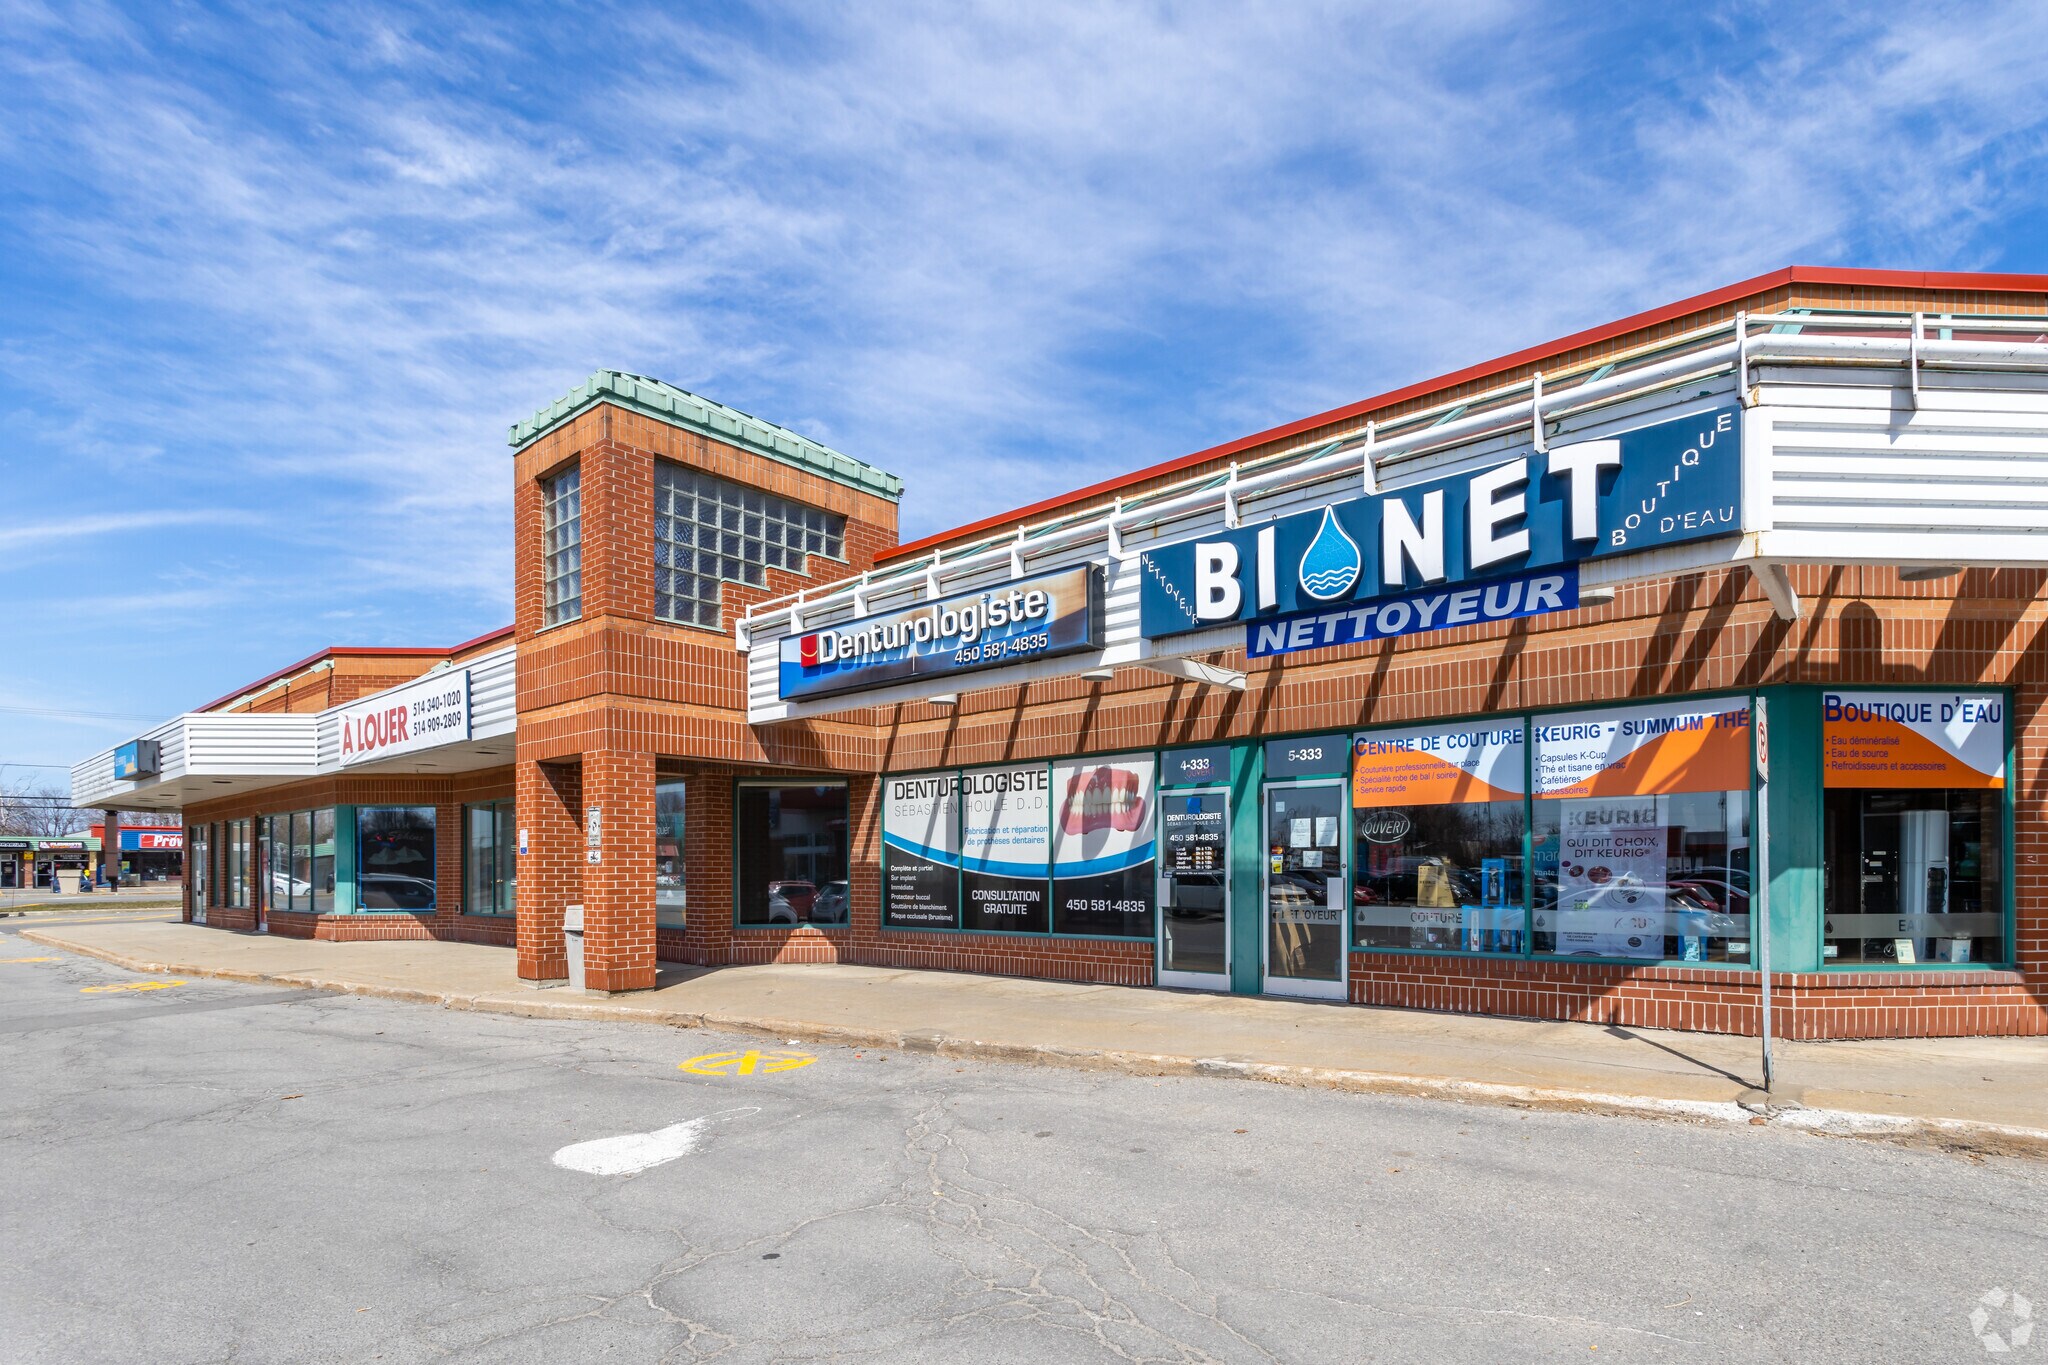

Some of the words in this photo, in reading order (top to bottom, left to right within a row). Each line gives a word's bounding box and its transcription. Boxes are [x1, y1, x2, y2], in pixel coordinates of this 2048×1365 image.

[1612, 413, 1732, 546] BOUTIQUE
[1661, 506, 1734, 533] D'EAU
[1142, 553, 1199, 624] NETTOYEUR
[1256, 575, 1565, 653] NETTOYEUR
[819, 589, 1049, 663] Denturologiste
[955, 647, 980, 664] 450
[983, 633, 1048, 658] 581-4835
[413, 700, 426, 717] 514
[427, 690, 461, 713] 340-1020
[1824, 695, 1932, 724] BOUTIQUE
[1941, 696, 2001, 723] D'EAU
[343, 715, 353, 755] À
[357, 705, 409, 752] LOUER
[413, 720, 426, 736] 514
[427, 711, 462, 733] 909-2809
[1535, 724, 1601, 743] KEURIG
[1622, 714, 1704, 736] SUMMUM
[1711, 708, 1749, 729] THÉ
[1355, 737, 1415, 757] CENTRE
[1421, 736, 1440, 751] DE
[1447, 728, 1523, 749] COUTURE
[1831, 736, 1847, 744] Eau
[1850, 735, 1900, 745] déminéralisé
[1288, 748, 1323, 762] 5-333
[1540, 753, 1578, 764] Capsules
[1580, 751, 1607, 761] K-Cup
[1831, 749, 1847, 758] Eau
[1850, 749, 1859, 758] de
[1862, 750, 1889, 758] source
[1180, 758, 1210, 771] 4-333
[1360, 765, 1393, 774] Couturière
[1395, 761, 1446, 773] professionnelle
[1461, 759, 1480, 768] place
[1541, 765, 1556, 774] Thé
[1558, 765, 1566, 773] et
[1568, 763, 1592, 772] tisane
[1608, 761, 1626, 770] vrac
[1831, 761, 1888, 771] Refroidisseurs
[1890, 762, 1898, 770] et
[1900, 762, 1947, 771] accessoires
[894, 770, 1048, 800] DENTUROLOGISTE
[1360, 775, 1391, 785] Spécialité
[1393, 774, 1408, 782] robe
[1409, 773, 1418, 781] de
[1419, 772, 1431, 781] bal
[1437, 771, 1458, 780] soirée
[1540, 775, 1582, 785] Cafétières
[1360, 786, 1385, 794] Service
[1386, 785, 1407, 795] rapide
[1540, 786, 1589, 796] Accessoires
[894, 801, 958, 817] SÉBASTIEN
[966, 798, 1008, 813] HOULE
[1017, 796, 1049, 810] D.D.
[1166, 812, 1222, 822] DENTUROLOGISTE
[1569, 809, 1657, 826] KEURIG
[964, 827, 1000, 835] Fabrication
[1002, 826, 1010, 834] et
[1011, 824, 1048, 835] réparation
[1364, 819, 1407, 835] OUVERT
[153, 834, 183, 847] Prov
[977, 837, 1011, 847] prothèses
[1012, 836, 1045, 845] dentaires
[1170, 834, 1184, 842] 450
[1185, 833, 1219, 842] 581-4835
[1567, 838, 1589, 848] QUI
[1592, 838, 1612, 847] DIT
[1615, 837, 1659, 848] CHOIX,
[1574, 849, 1595, 858] DIT
[971, 889, 1040, 903] CONSULTATION
[983, 903, 1028, 915] GRATUITE
[1066, 899, 1088, 912] 450
[1090, 899, 1146, 913] 581-4835
[1410, 911, 1463, 924] COUTURE
